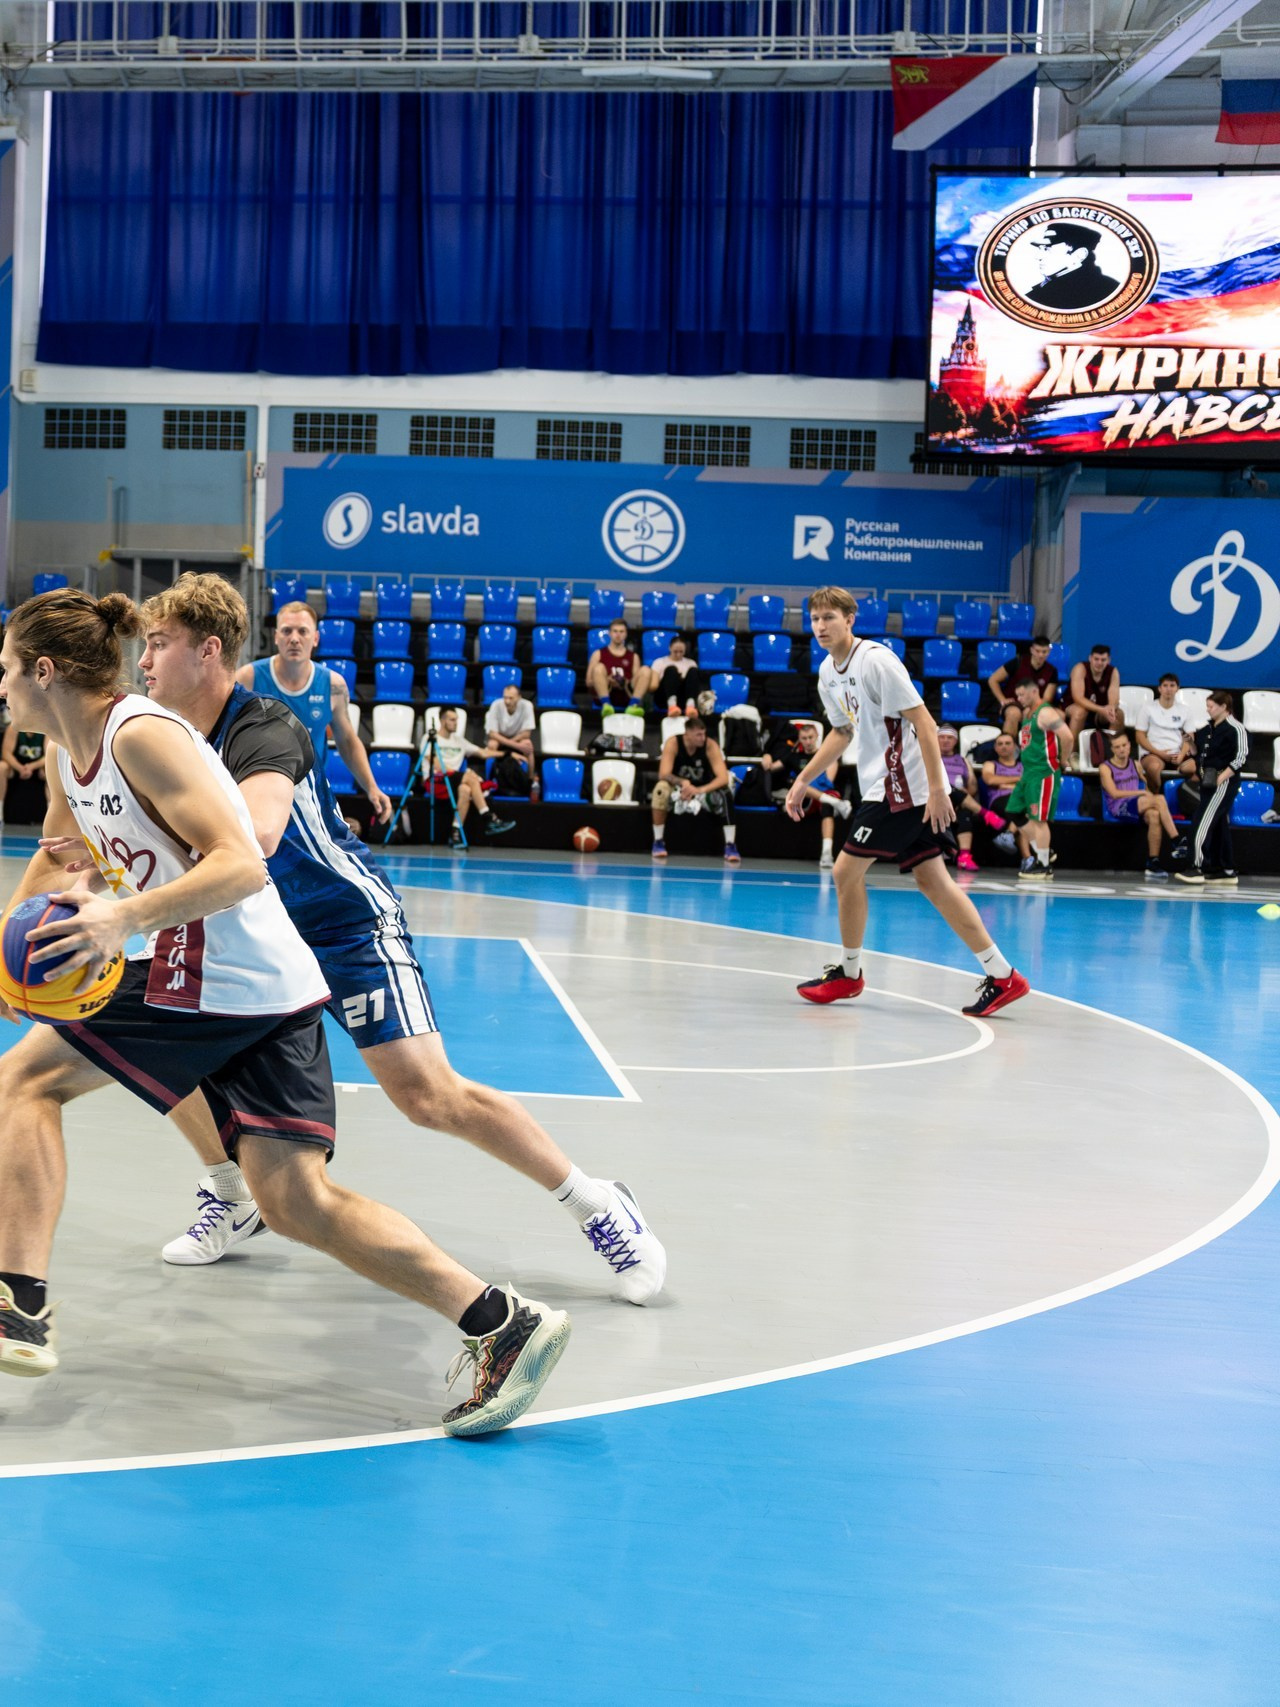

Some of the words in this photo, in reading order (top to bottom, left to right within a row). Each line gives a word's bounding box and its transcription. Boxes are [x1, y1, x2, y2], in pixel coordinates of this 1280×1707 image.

[994, 219, 1030, 257] ТУРНИР
[1030, 210, 1050, 225] ПО
[1052, 207, 1132, 239] БАСКЕТБОЛУ
[381, 503, 480, 536] slavda
[845, 518, 900, 533] Русская
[845, 533, 984, 551] Рыбопромышленная
[844, 547, 912, 562] Компания
[854, 825, 872, 843] 47
[342, 988, 385, 1028] 21
